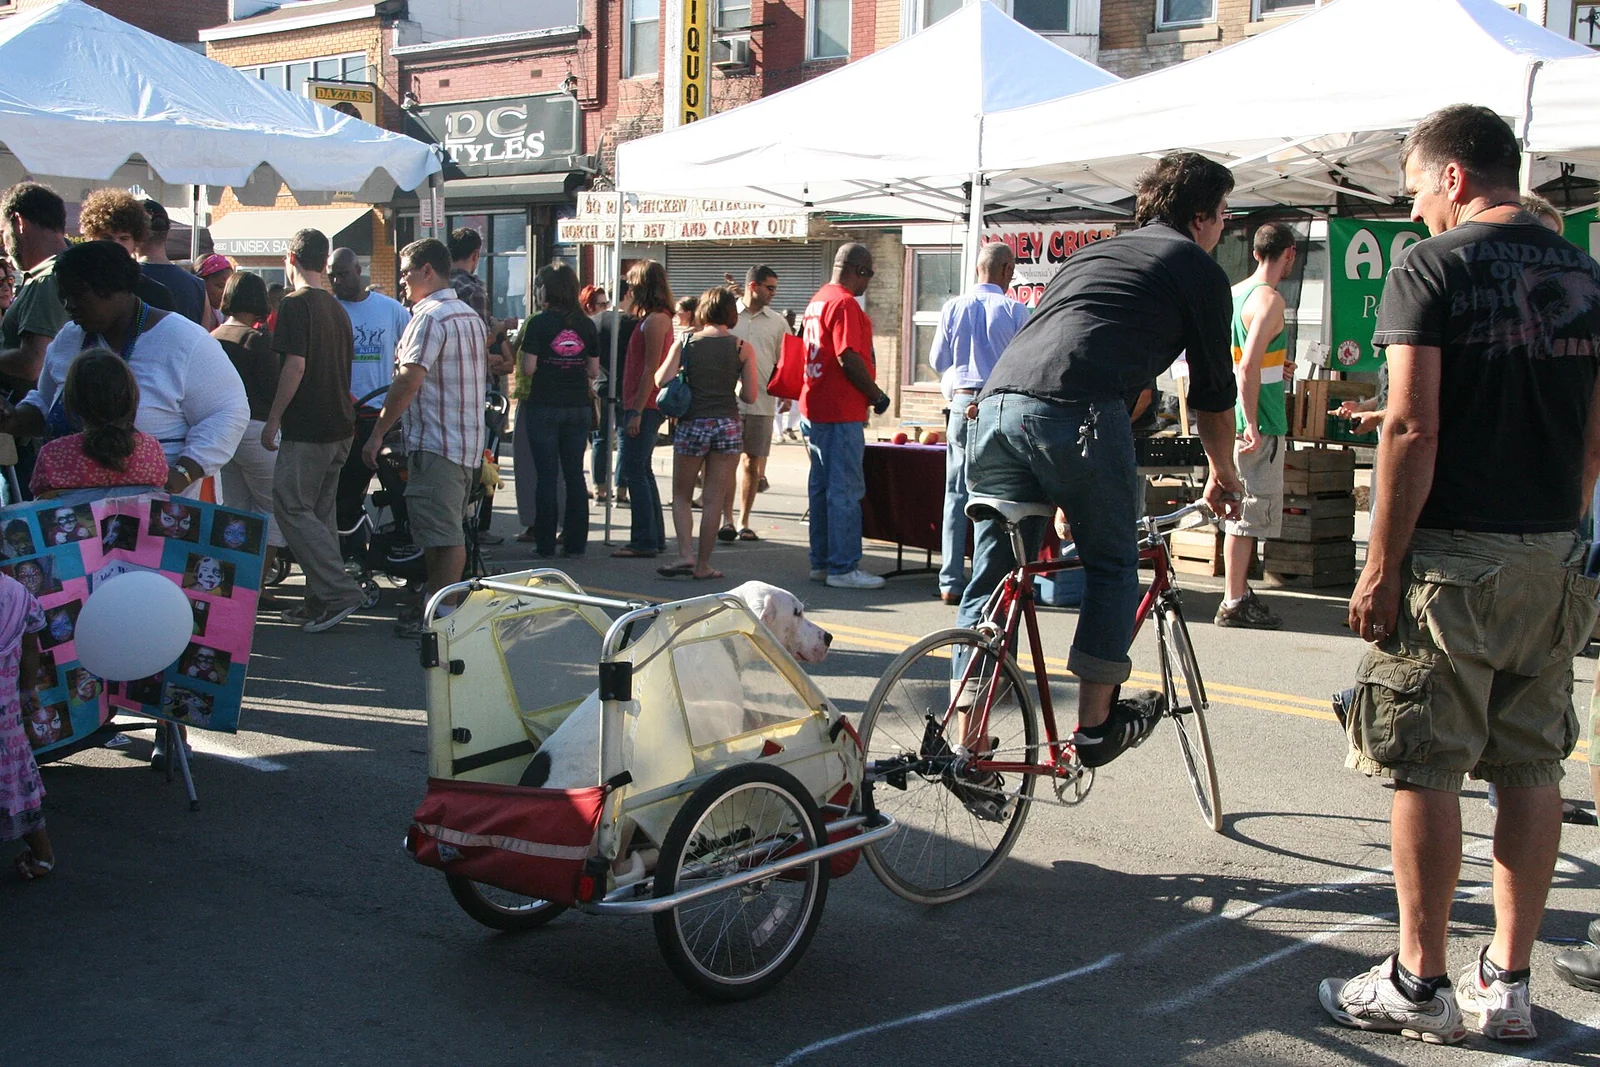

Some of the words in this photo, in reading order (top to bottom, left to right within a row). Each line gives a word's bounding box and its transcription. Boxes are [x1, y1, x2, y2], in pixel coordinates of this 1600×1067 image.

[686, 0, 700, 124] IQUO
[317, 87, 373, 103] DAZZLES
[445, 104, 528, 143] DC
[439, 130, 545, 163] TYLES
[607, 199, 631, 214] RIS
[637, 199, 687, 213] CHICKEN
[561, 224, 598, 238] NORTH
[643, 223, 665, 238] BEV
[681, 222, 707, 237] AND
[714, 220, 759, 236] CARRY
[767, 219, 797, 234] OUT
[230, 240, 270, 253] UNISEX
[272, 240, 289, 253] SA
